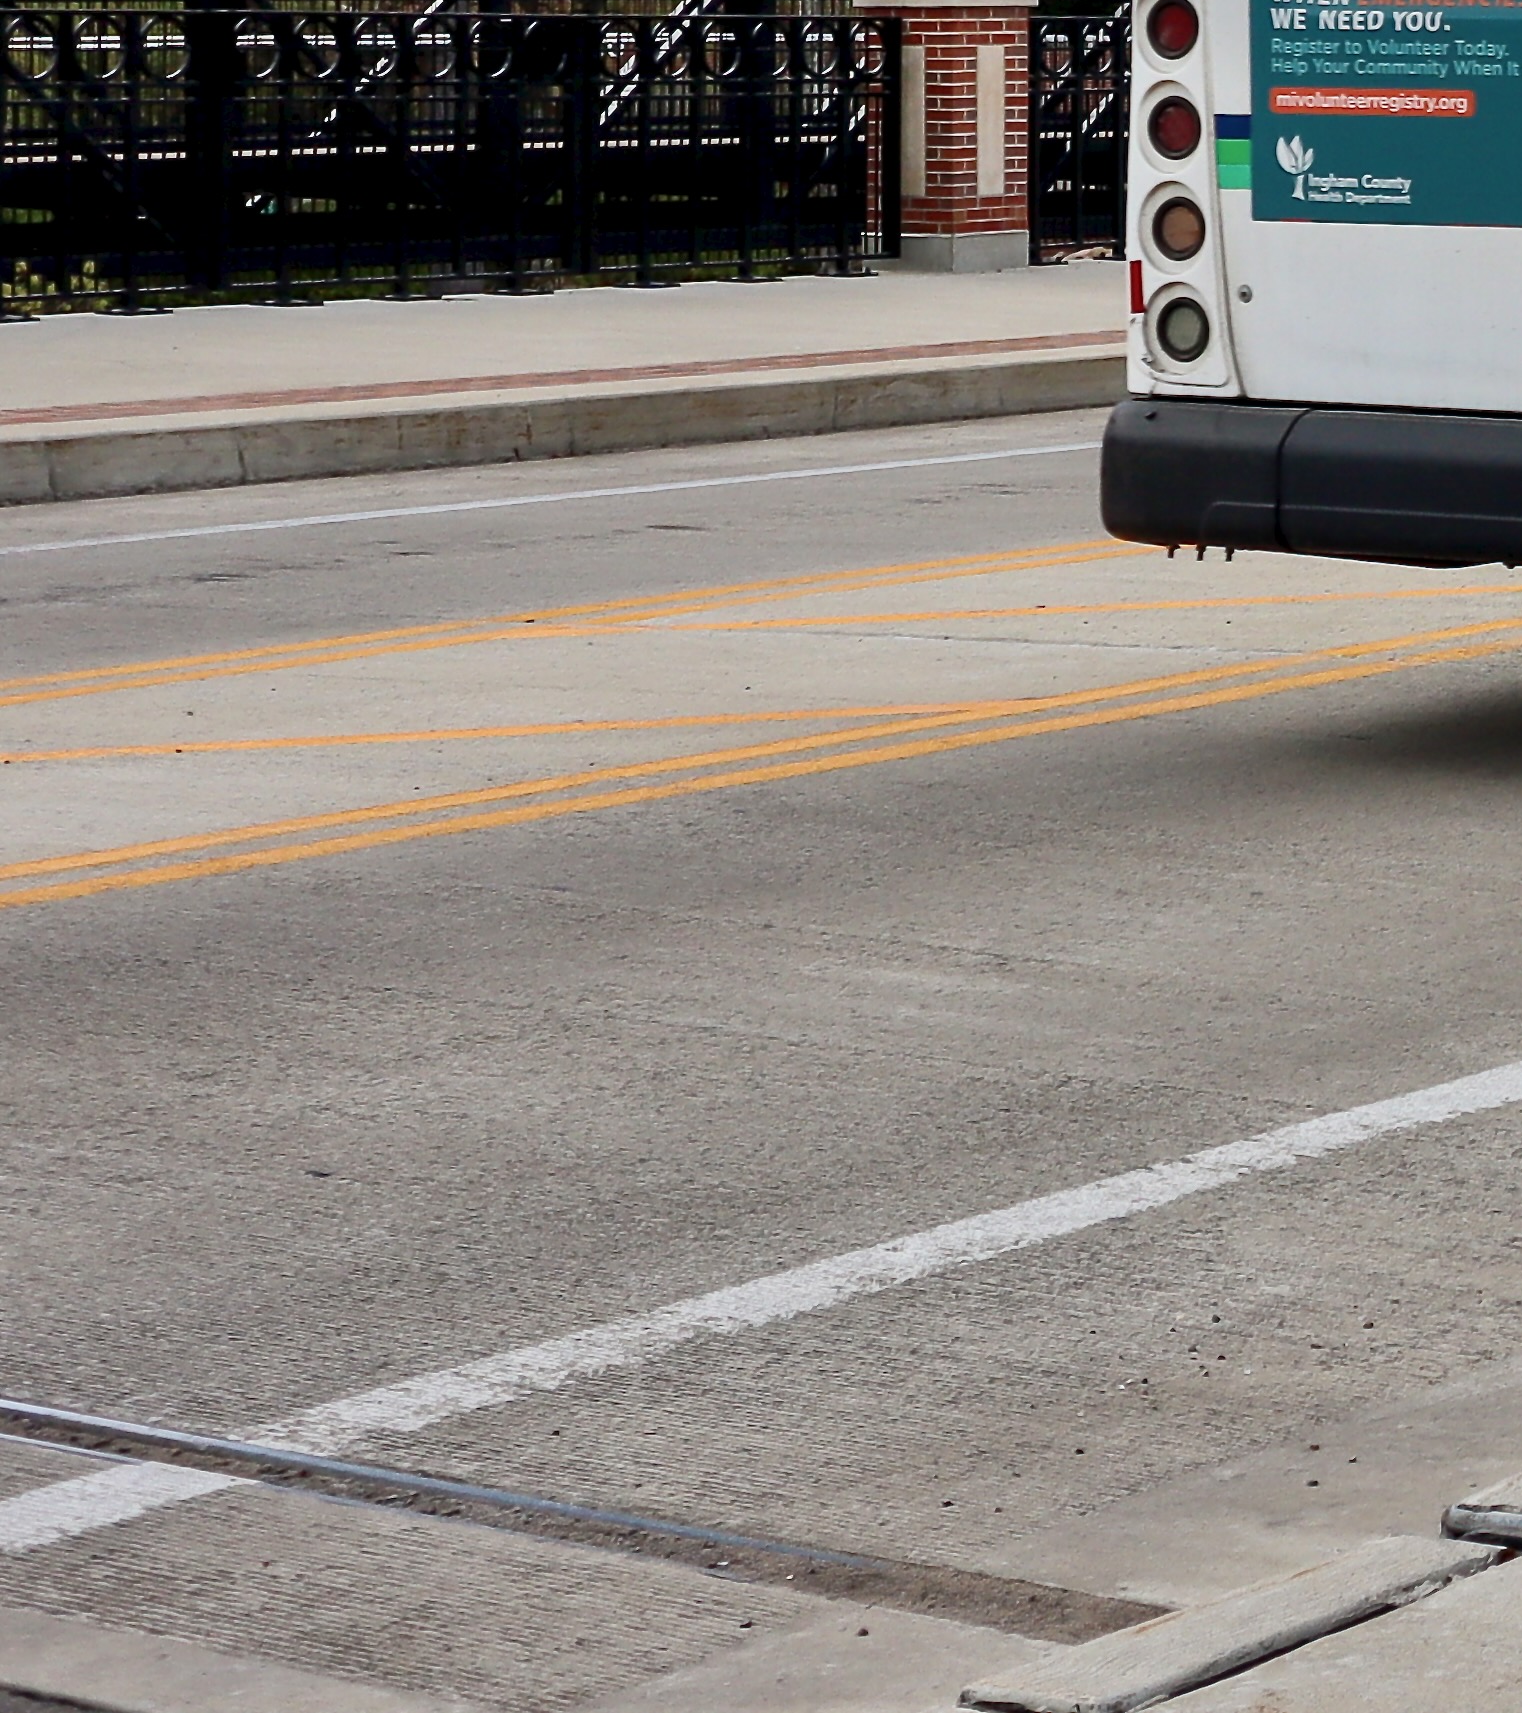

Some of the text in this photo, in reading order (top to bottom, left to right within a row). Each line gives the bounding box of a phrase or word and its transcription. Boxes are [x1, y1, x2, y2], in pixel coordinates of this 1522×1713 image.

[1270, 7, 1451, 32] WE NEED YOU.
[1271, 38, 1510, 60] Register to Volunteer Today.
[1271, 58, 1309, 76] Help
[1312, 58, 1350, 74] Your
[1354, 59, 1448, 78] Community
[1453, 60, 1502, 76] When
[1507, 61, 1520, 77] It
[1275, 91, 1468, 113] mivolunteerregistry.org
[1308, 173, 1412, 194] Ingham County
